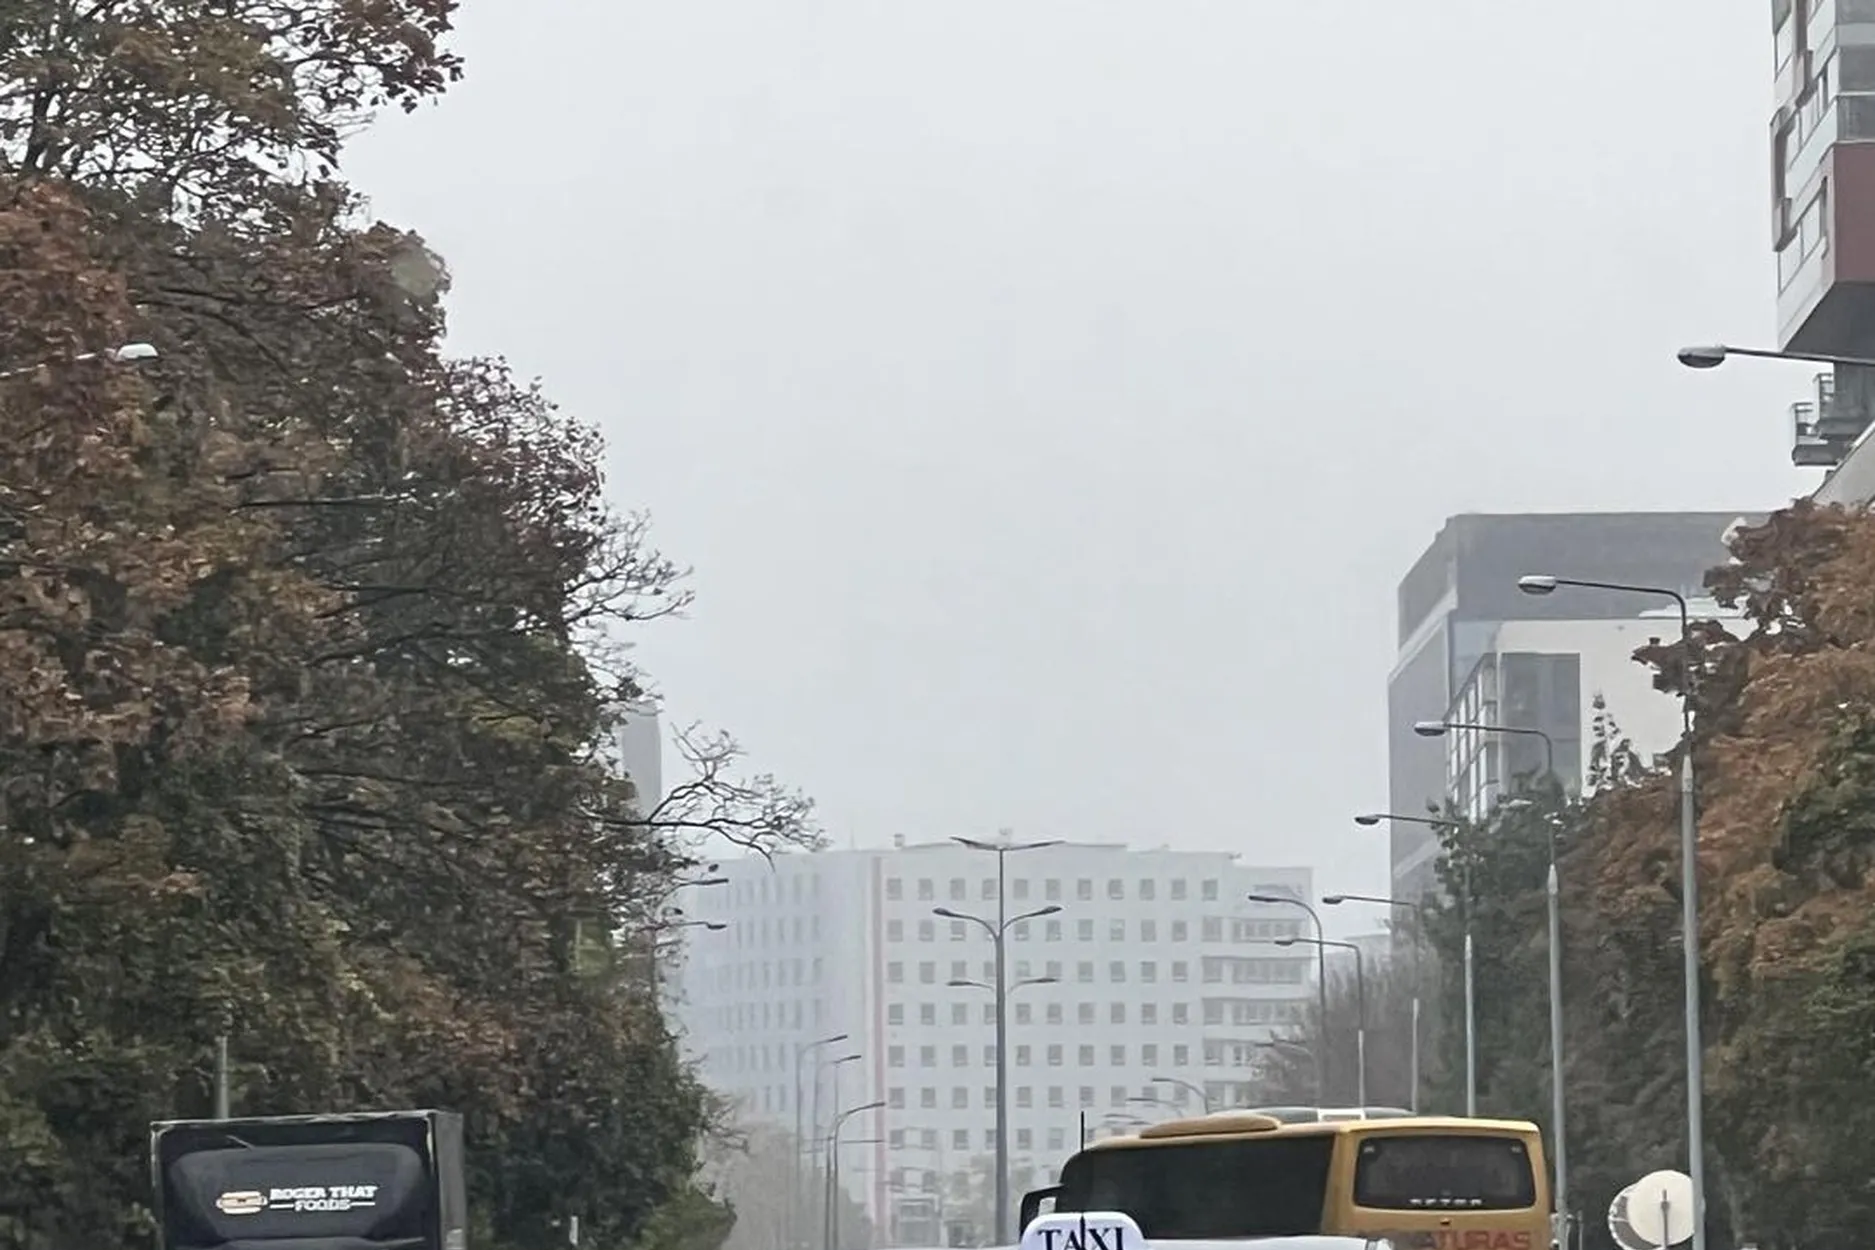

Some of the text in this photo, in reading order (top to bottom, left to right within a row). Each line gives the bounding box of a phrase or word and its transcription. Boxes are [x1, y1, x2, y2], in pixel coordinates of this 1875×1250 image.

[269, 1185, 379, 1200] ROGER THAT
[294, 1199, 351, 1212] FOODS
